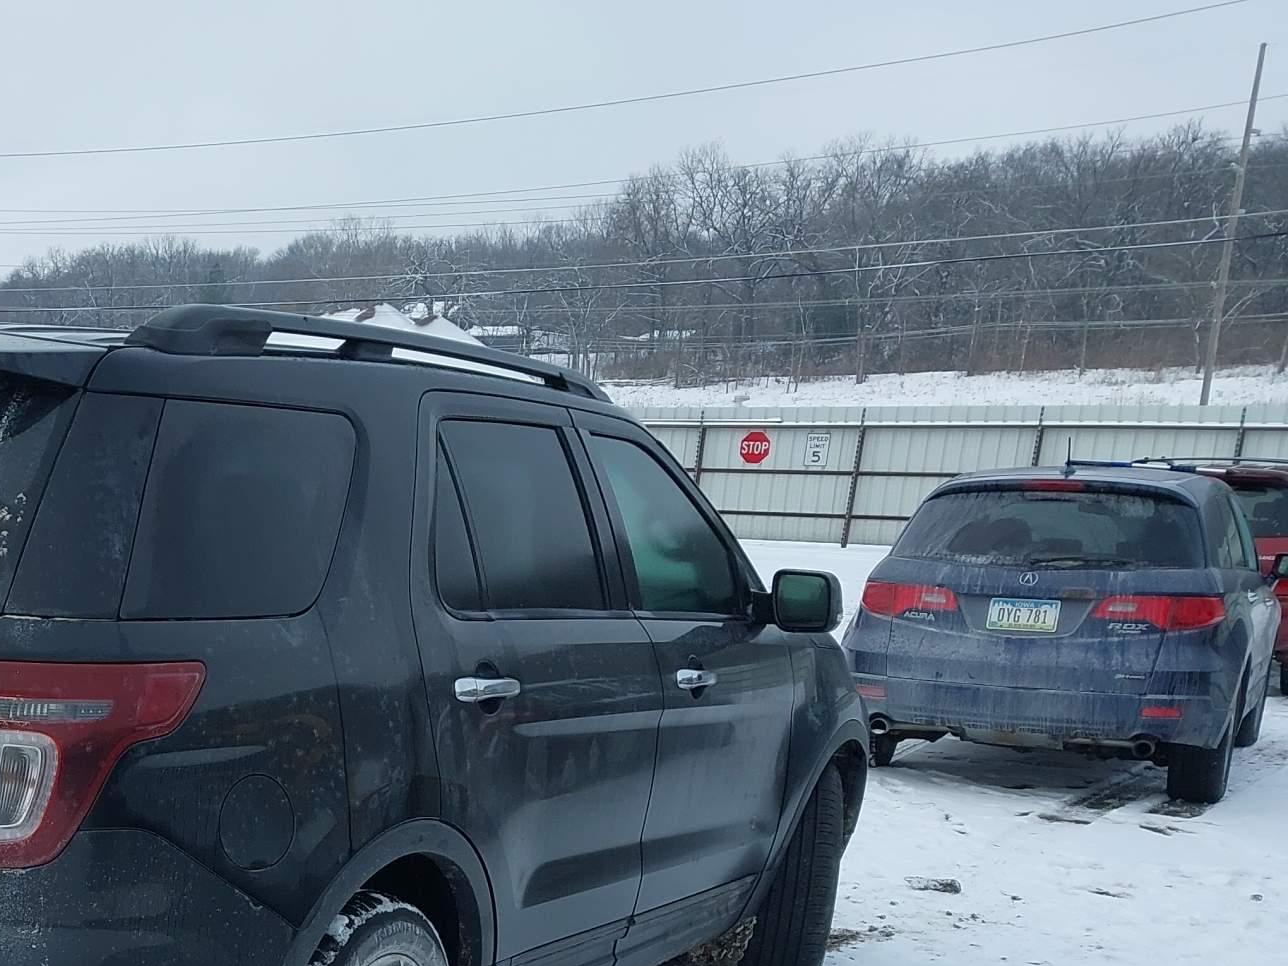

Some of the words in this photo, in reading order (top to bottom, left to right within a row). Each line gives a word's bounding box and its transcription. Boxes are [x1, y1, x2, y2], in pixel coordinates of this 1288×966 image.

[741, 441, 769, 454] STOP
[811, 451, 821, 463] 5
[904, 611, 935, 621] ACURA
[1027, 609, 1048, 624] 781
[1108, 622, 1150, 630] RDX
